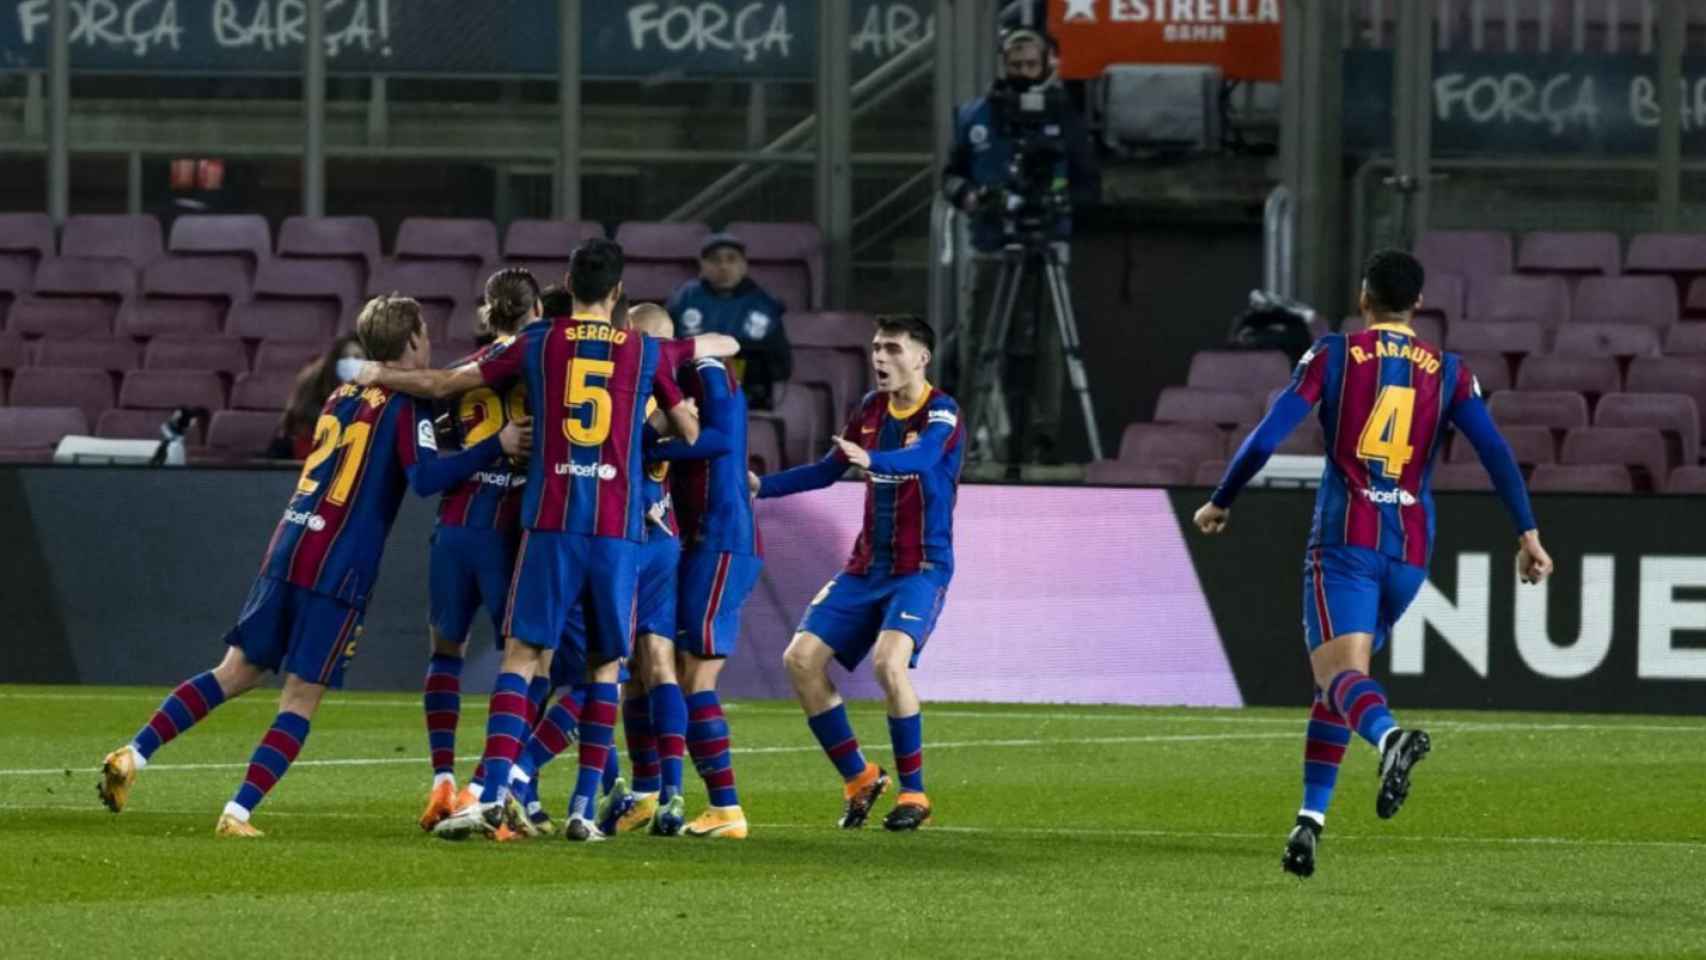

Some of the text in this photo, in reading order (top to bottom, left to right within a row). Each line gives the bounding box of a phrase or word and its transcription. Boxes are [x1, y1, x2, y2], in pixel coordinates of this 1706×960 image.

[627, 3, 793, 62] FORÇA
[1109, 0, 1280, 23] ESTRELLA
[1434, 73, 1600, 134] FORÇA
[564, 324, 628, 345] SERGIO
[1349, 341, 1442, 375] R. ARAUJO
[562, 357, 615, 447] 5
[1356, 385, 1417, 479] 4
[297, 414, 372, 507] 21
[554, 461, 598, 478] unicef
[1388, 552, 1706, 680] NUE
